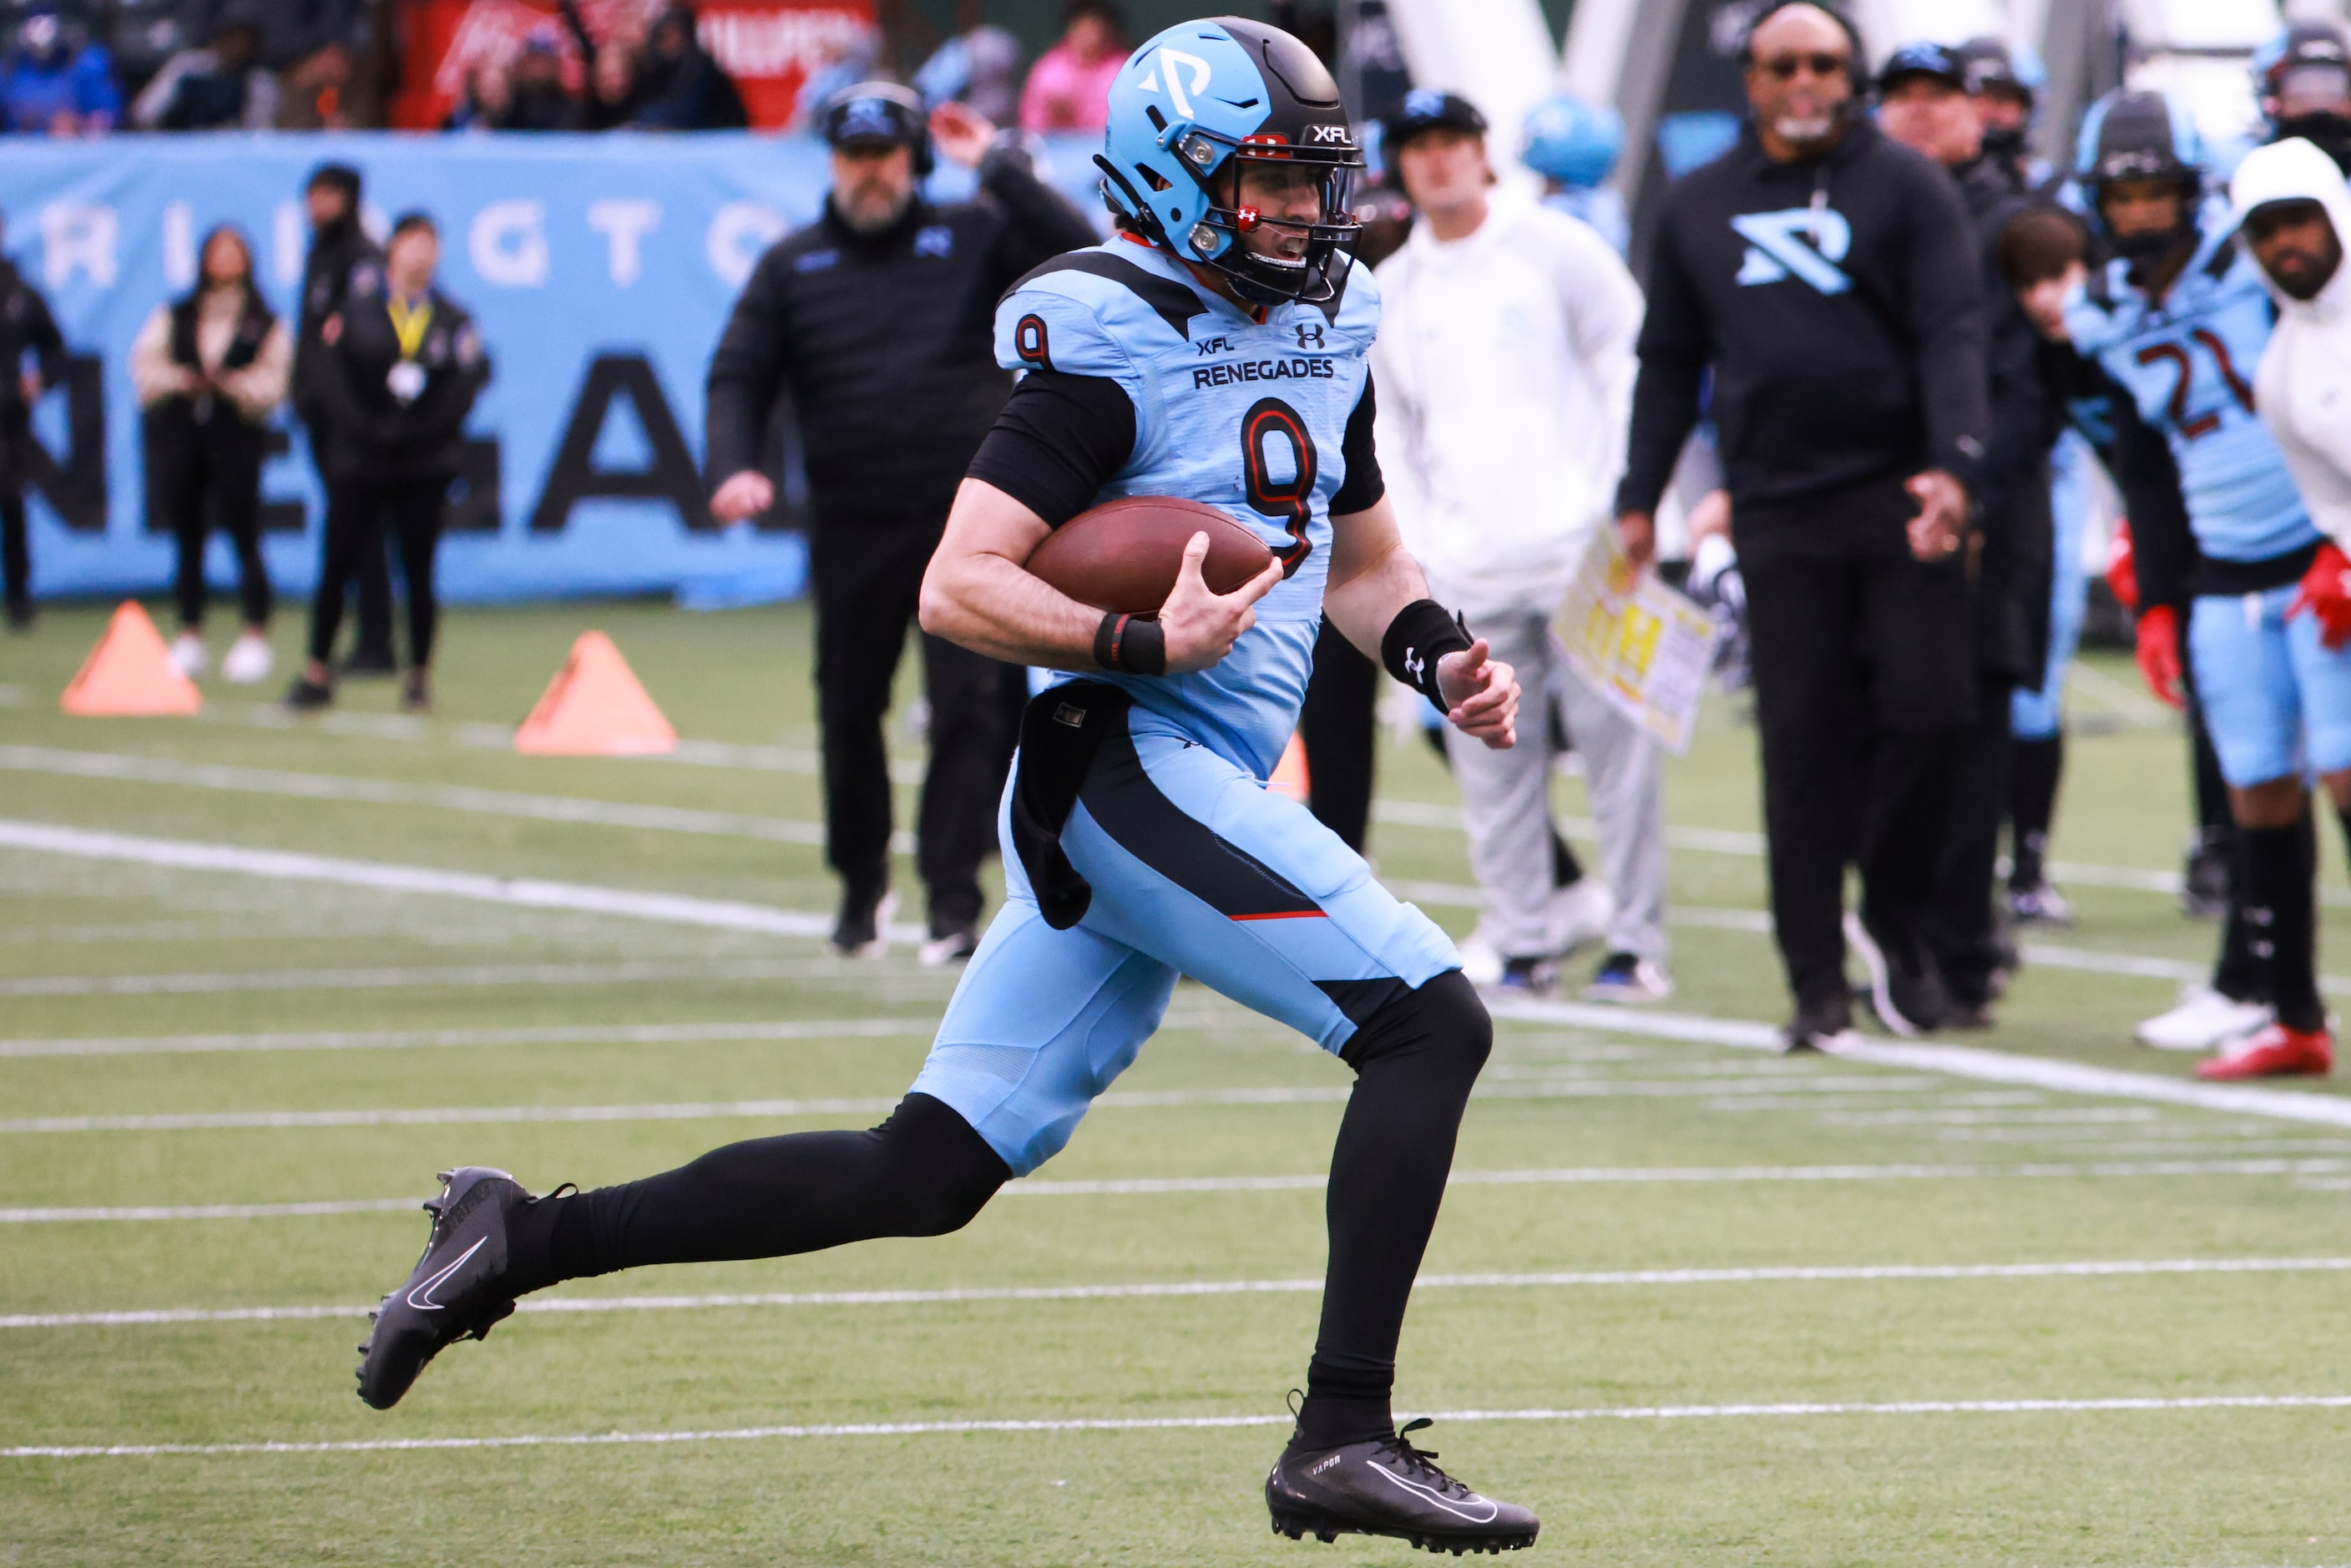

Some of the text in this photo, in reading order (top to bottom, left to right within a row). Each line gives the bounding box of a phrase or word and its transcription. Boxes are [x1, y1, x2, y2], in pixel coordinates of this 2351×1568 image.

[1312, 125, 1352, 144] XFL
[1014, 313, 1055, 372] 9
[1196, 336, 1235, 357] XFL
[1192, 359, 1334, 390] RENEGADES
[1241, 397, 1318, 579] 9
[1312, 1454, 1341, 1476] VAPOR
